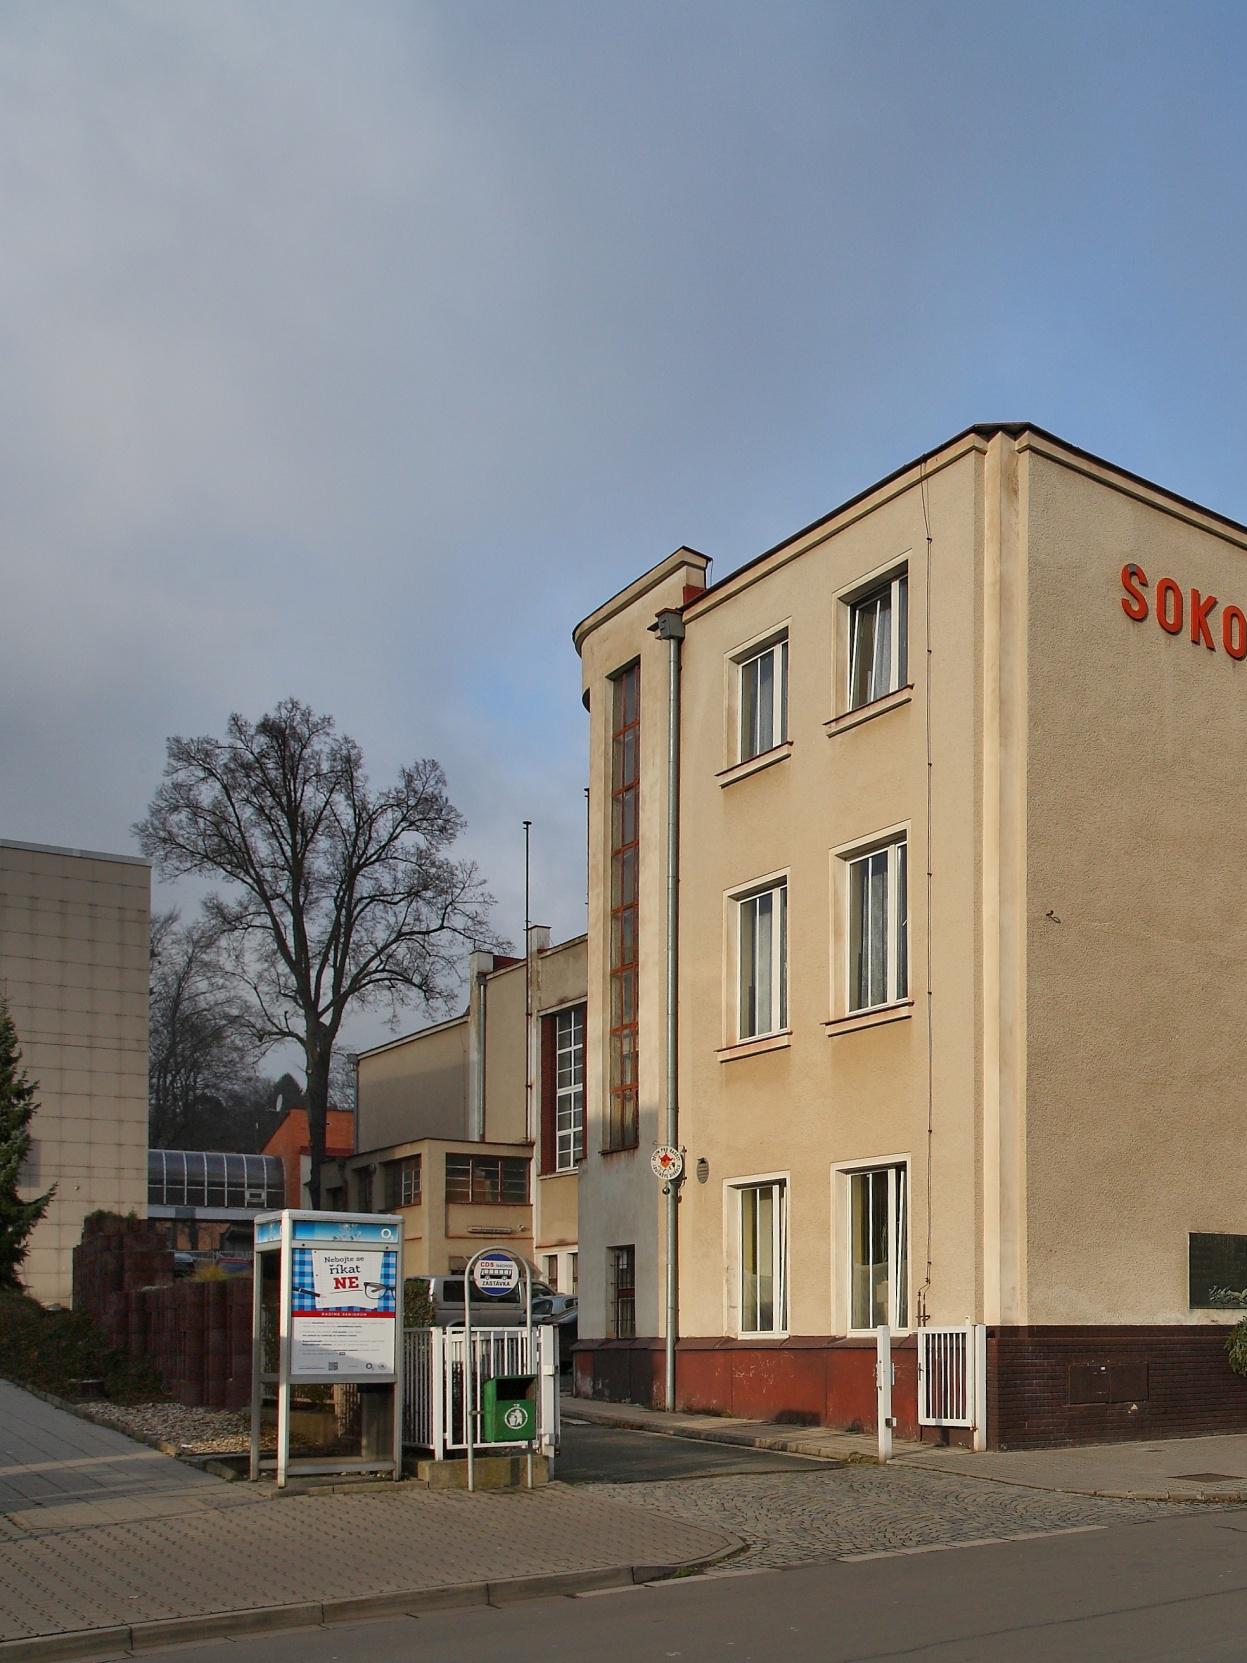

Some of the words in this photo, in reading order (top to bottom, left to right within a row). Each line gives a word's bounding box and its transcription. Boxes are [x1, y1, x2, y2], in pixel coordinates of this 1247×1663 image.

[324, 1256, 355, 1264] Nebojte
[329, 1264, 361, 1275] říkat
[333, 1276, 359, 1290] NE
